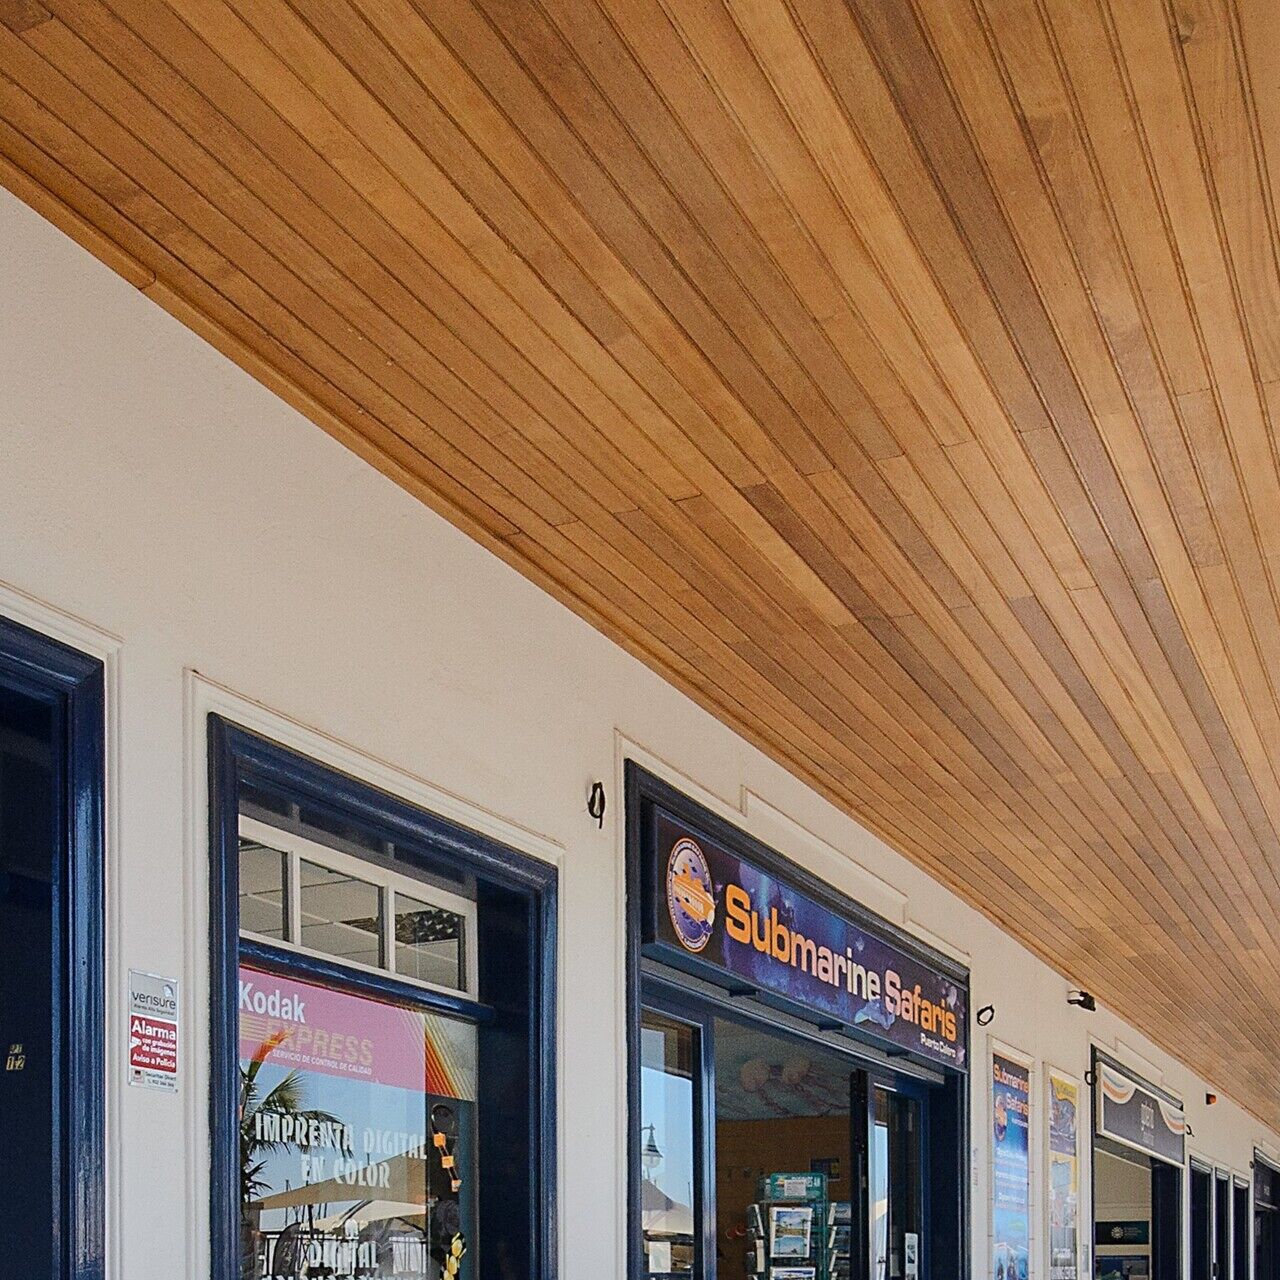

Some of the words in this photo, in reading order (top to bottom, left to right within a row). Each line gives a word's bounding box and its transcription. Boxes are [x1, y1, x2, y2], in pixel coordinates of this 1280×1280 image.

[725, 883, 880, 1003] Submarine
[885, 969, 958, 1042] Safaris
[131, 991, 177, 1010] verisure
[239, 980, 306, 1024] Kodak
[131, 1019, 176, 1041] Alarma
[266, 1018, 373, 1067] EXPRESS
[993, 1063, 1029, 1094] Submarine
[1006, 1091, 1029, 1117] Safaris
[255, 1112, 355, 1151] IMPRENTA
[363, 1127, 428, 1161] DIGITAL
[300, 1153, 325, 1182] EN
[333, 1157, 390, 1189] COLOR
